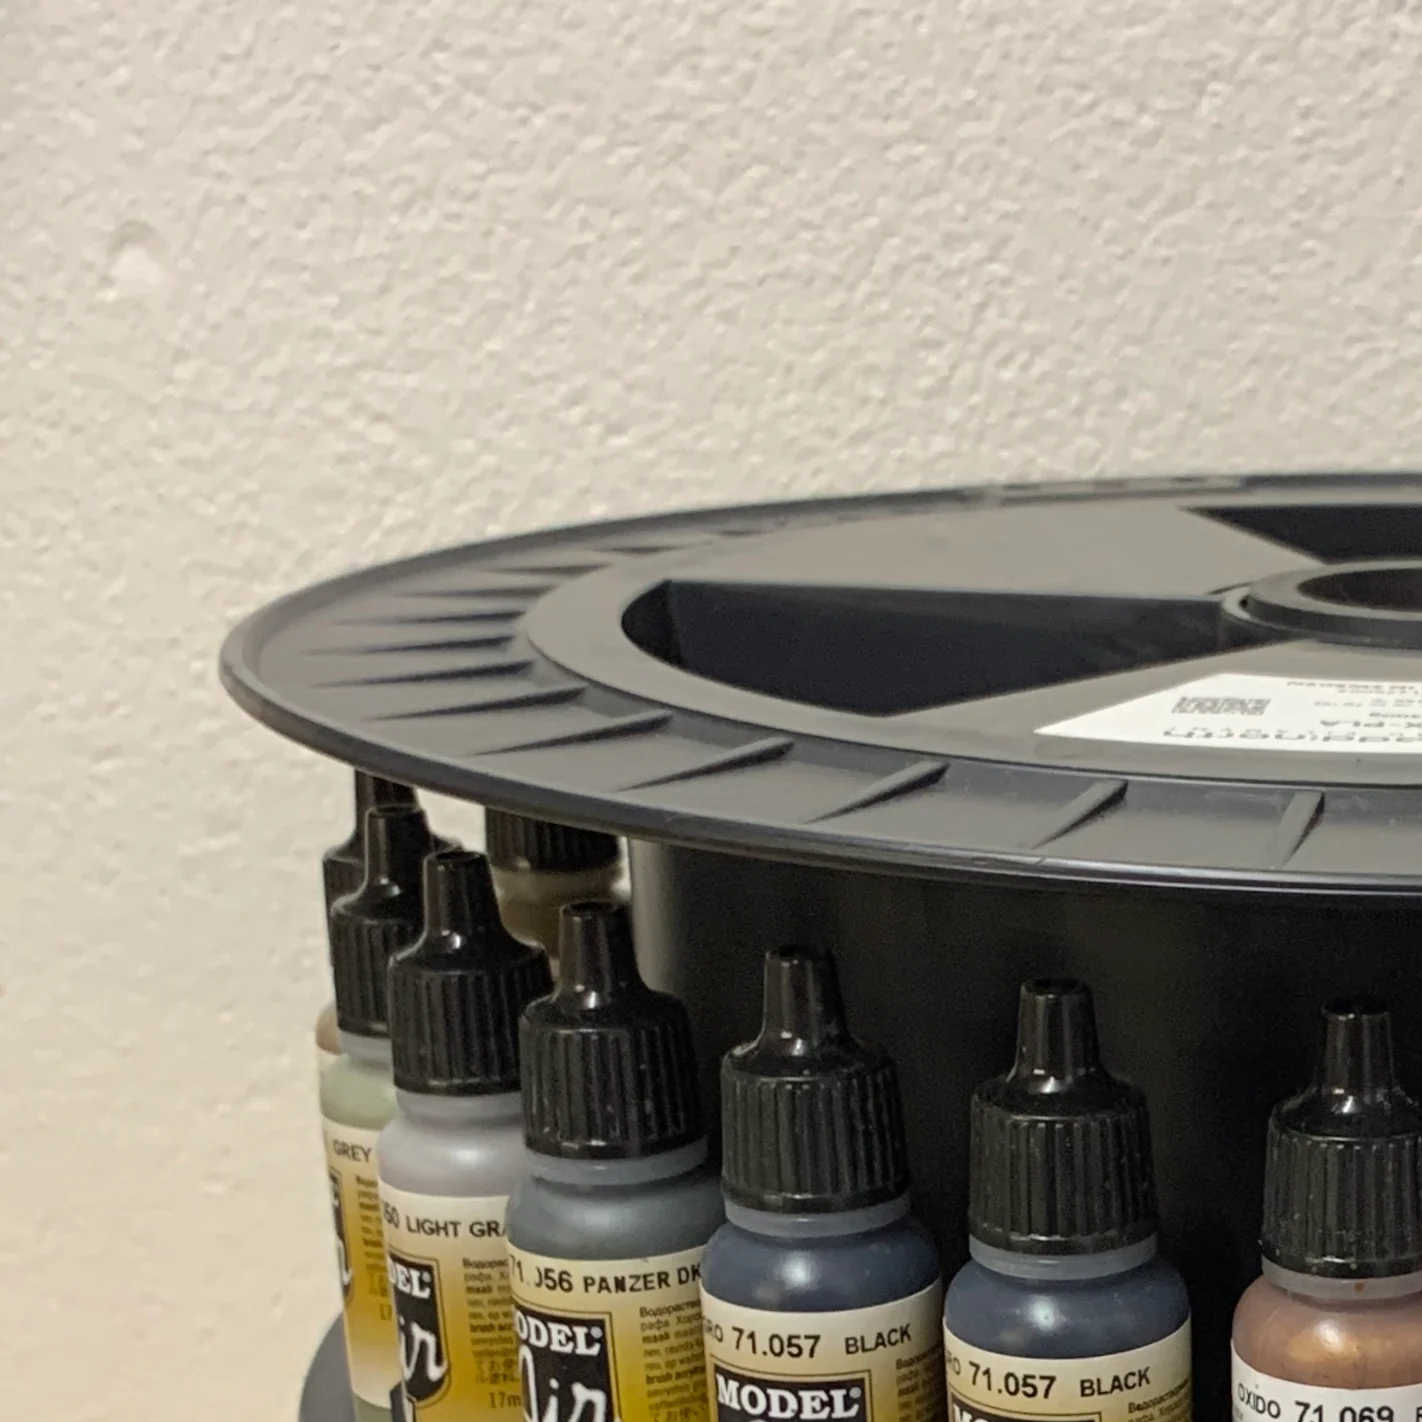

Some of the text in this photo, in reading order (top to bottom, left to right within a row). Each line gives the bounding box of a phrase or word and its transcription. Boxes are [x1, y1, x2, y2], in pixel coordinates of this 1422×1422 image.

[406, 1214, 506, 1238] LIGHT GR
[583, 1269, 670, 1294] PANZER
[514, 1308, 604, 1357] ODEL
[732, 1326, 821, 1359] 71.057
[844, 1323, 912, 1356] BLACK
[714, 1372, 861, 1420] MODEL
[968, 1363, 1151, 1400] 71.057 BLACK
[1237, 1381, 1282, 1420] OXIDO
